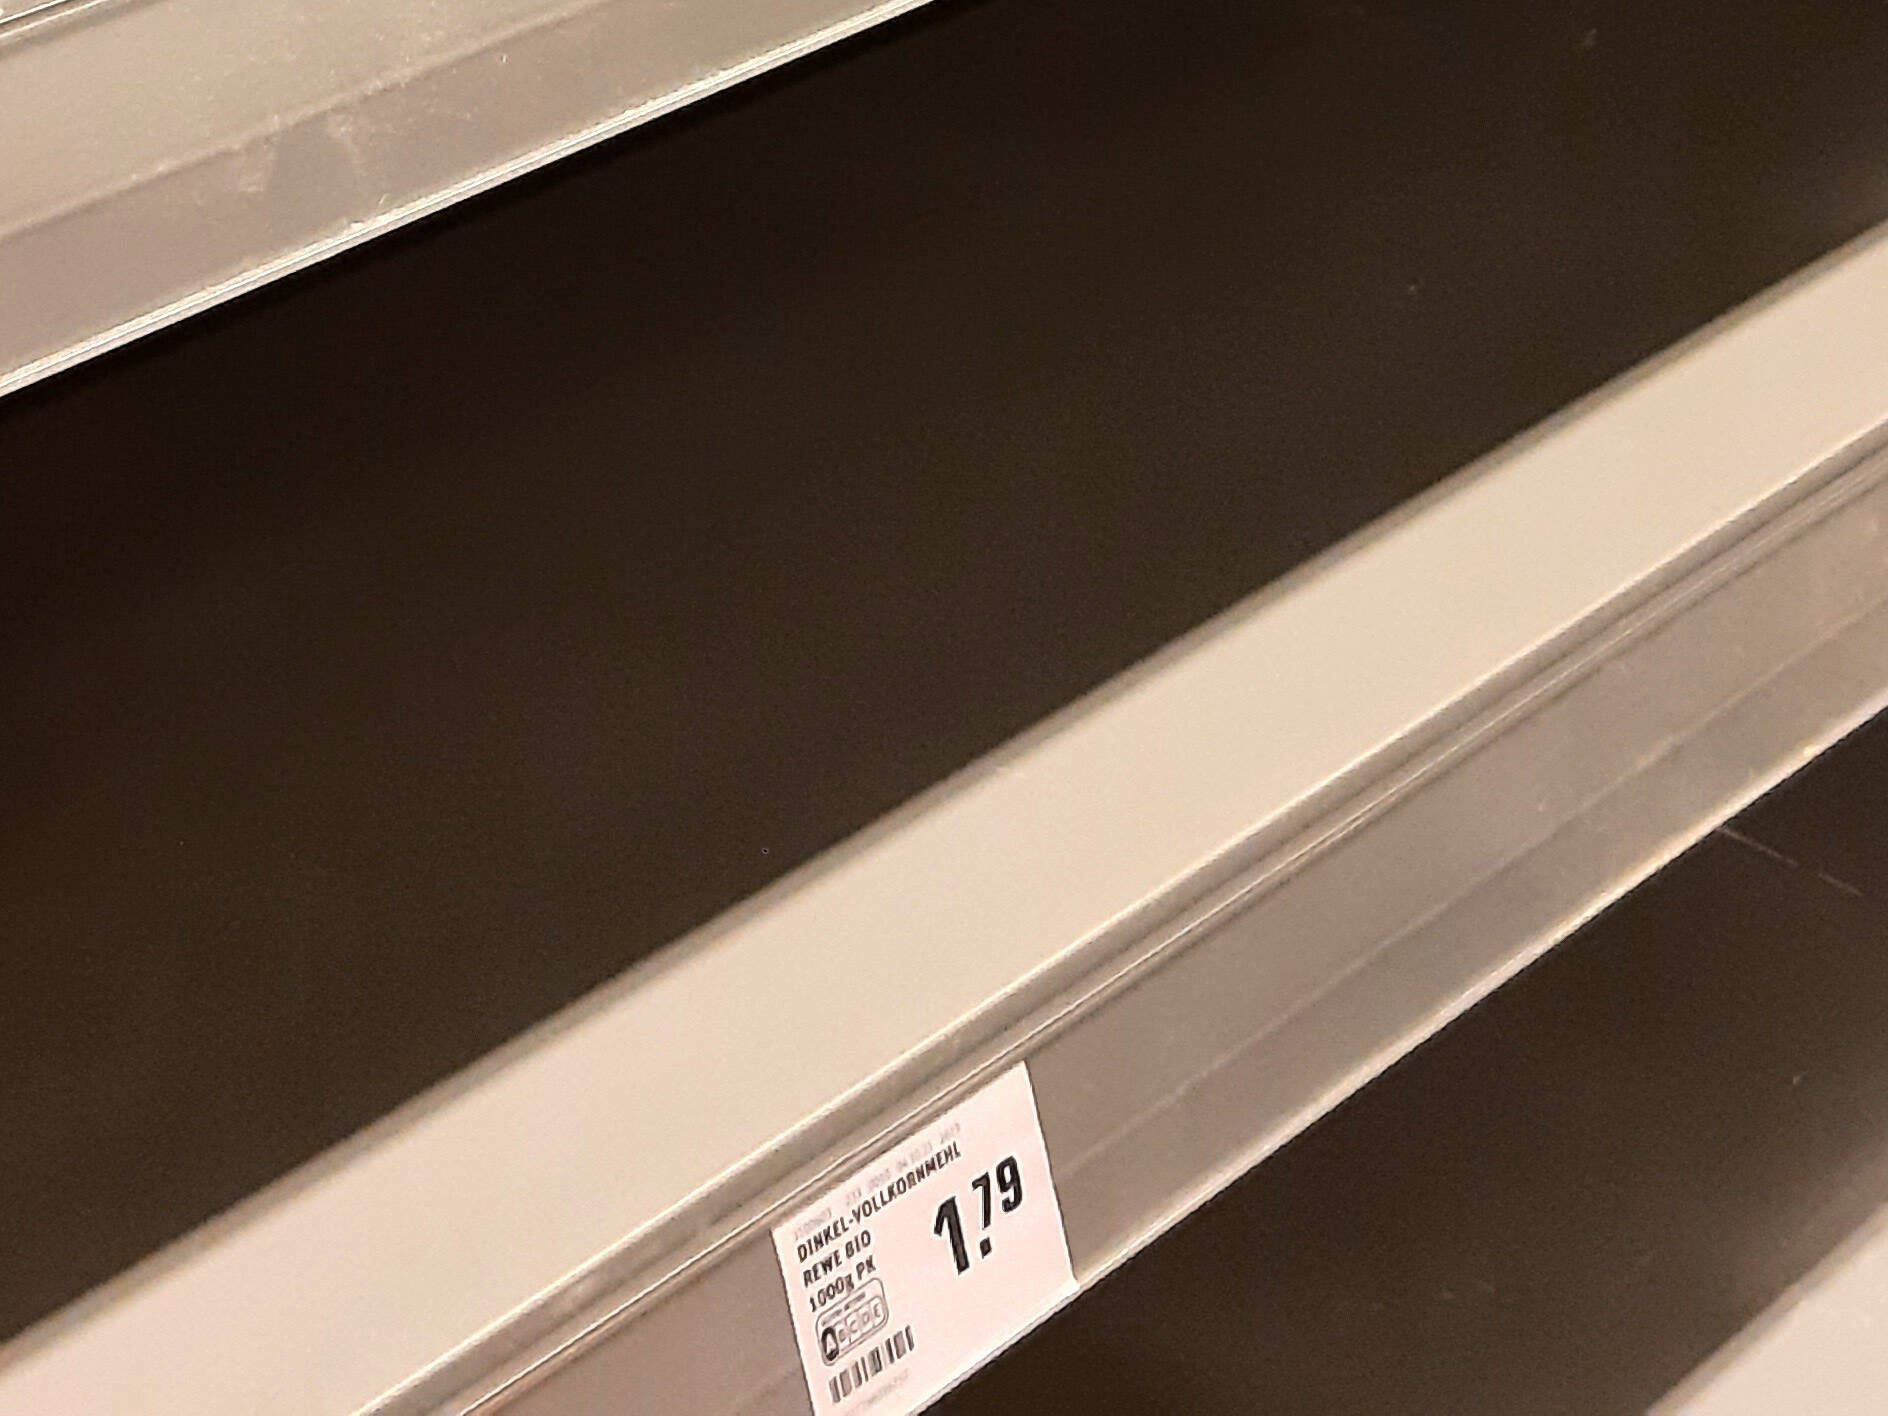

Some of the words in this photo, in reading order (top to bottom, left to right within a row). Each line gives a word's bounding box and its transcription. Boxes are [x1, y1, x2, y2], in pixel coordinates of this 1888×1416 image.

[797, 1140, 961, 1264] DINKEL-VOLLKORNMEHL
[934, 1155, 1024, 1275] 1.79
[803, 1250, 844, 1288] REWE
[845, 1229, 871, 1258] BIO
[856, 1255, 877, 1282] PK
